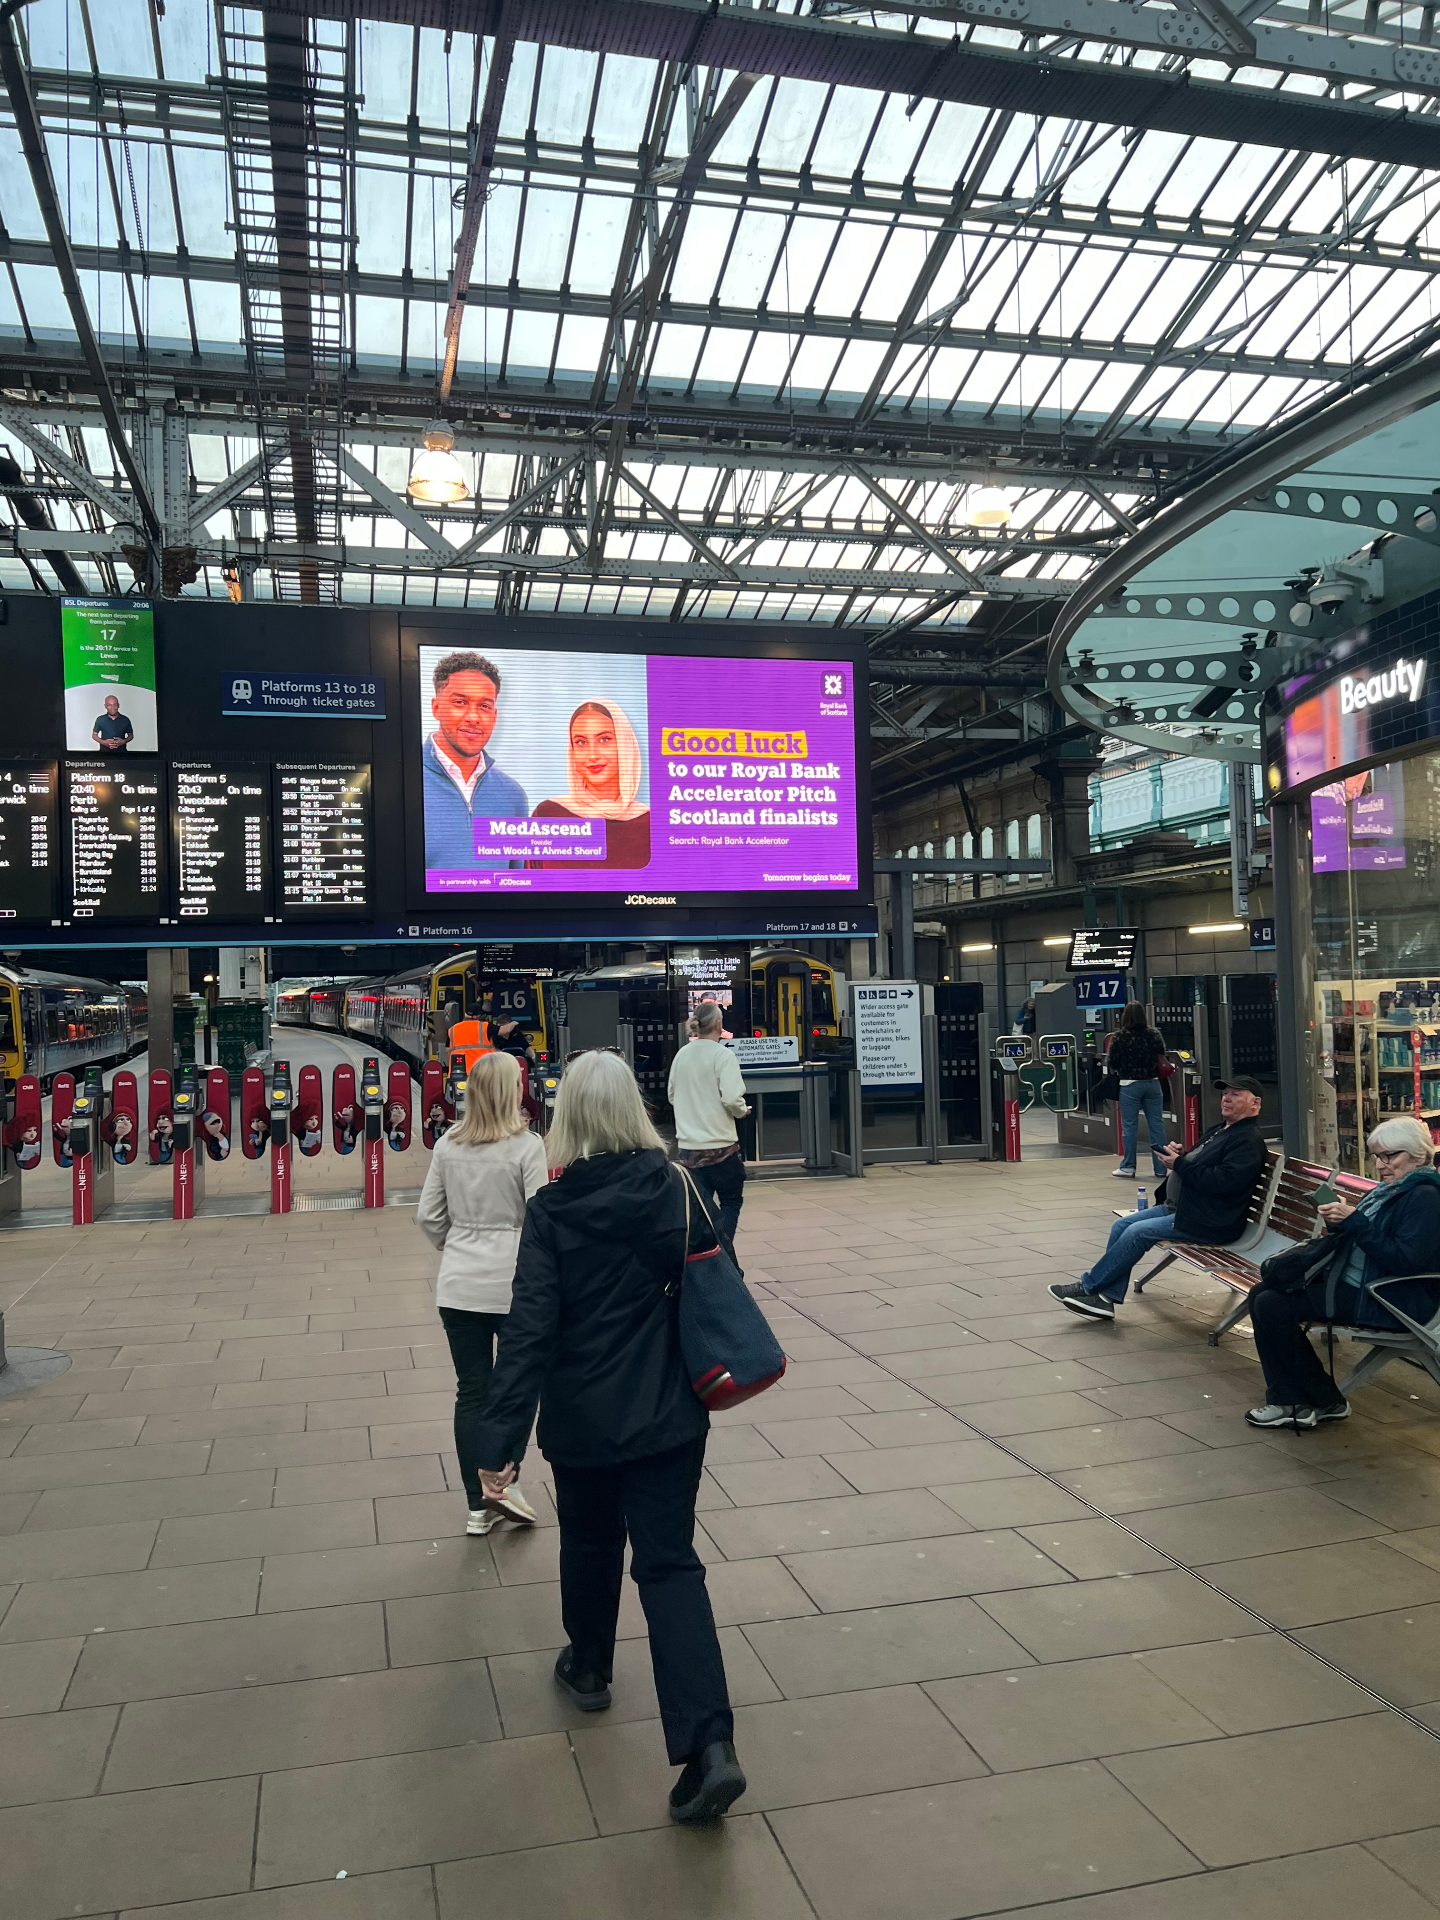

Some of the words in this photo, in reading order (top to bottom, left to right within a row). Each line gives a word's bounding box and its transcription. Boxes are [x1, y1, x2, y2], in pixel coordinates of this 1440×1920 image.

[100, 630, 116, 640] 17
[261, 680, 322, 693] Platforms
[325, 682, 340, 693] 13
[344, 683, 357, 694] to
[360, 684, 376, 694] 18
[1340, 658, 1425, 715] Beauty
[262, 695, 307, 708] Through
[313, 697, 343, 706] ticket
[346, 698, 376, 709] gates
[667, 731, 737, 753] Good
[745, 733, 803, 754] luck
[4, 773, 12, 781] 4
[668, 762, 688, 777] to
[693, 764, 727, 777] our
[731, 762, 787, 782] Royal
[791, 763, 840, 779] Bank
[71, 773, 111, 782] Platform
[114, 773, 125, 782] 18
[178, 774, 217, 783] Platform
[220, 774, 226, 783] 5
[13, 784, 26, 793] On
[29, 784, 49, 794] time
[70, 784, 95, 793] 20:40
[122, 785, 134, 793] On
[137, 785, 157, 794] time
[178, 785, 201, 794] 20:43
[227, 786, 240, 794] On
[243, 786, 262, 794] time
[668, 785, 783, 801] Accelerator
[787, 786, 837, 802] Pitch
[0, 795, 26, 804] erwick
[70, 796, 97, 804] Perth
[178, 796, 228, 805] Tweedbank
[669, 808, 755, 824] Scotland
[759, 808, 838, 825] finalists
[489, 821, 592, 836] MedAscend
[669, 836, 700, 845] Search:
[701, 836, 722, 846] Royal
[478, 846, 501, 855] Hana
[502, 846, 532, 855] Woods
[534, 847, 540, 855] &
[542, 847, 572, 855] Ahmed
[574, 847, 602, 855] Sharaf
[803, 874, 828, 882] begins
[624, 895, 676, 906] JCDecaux
[422, 927, 460, 936] Platform
[462, 927, 473, 935] 16
[1078, 982, 1090, 998] 17
[1098, 981, 1119, 997] 17
[500, 991, 526, 1008] 16
